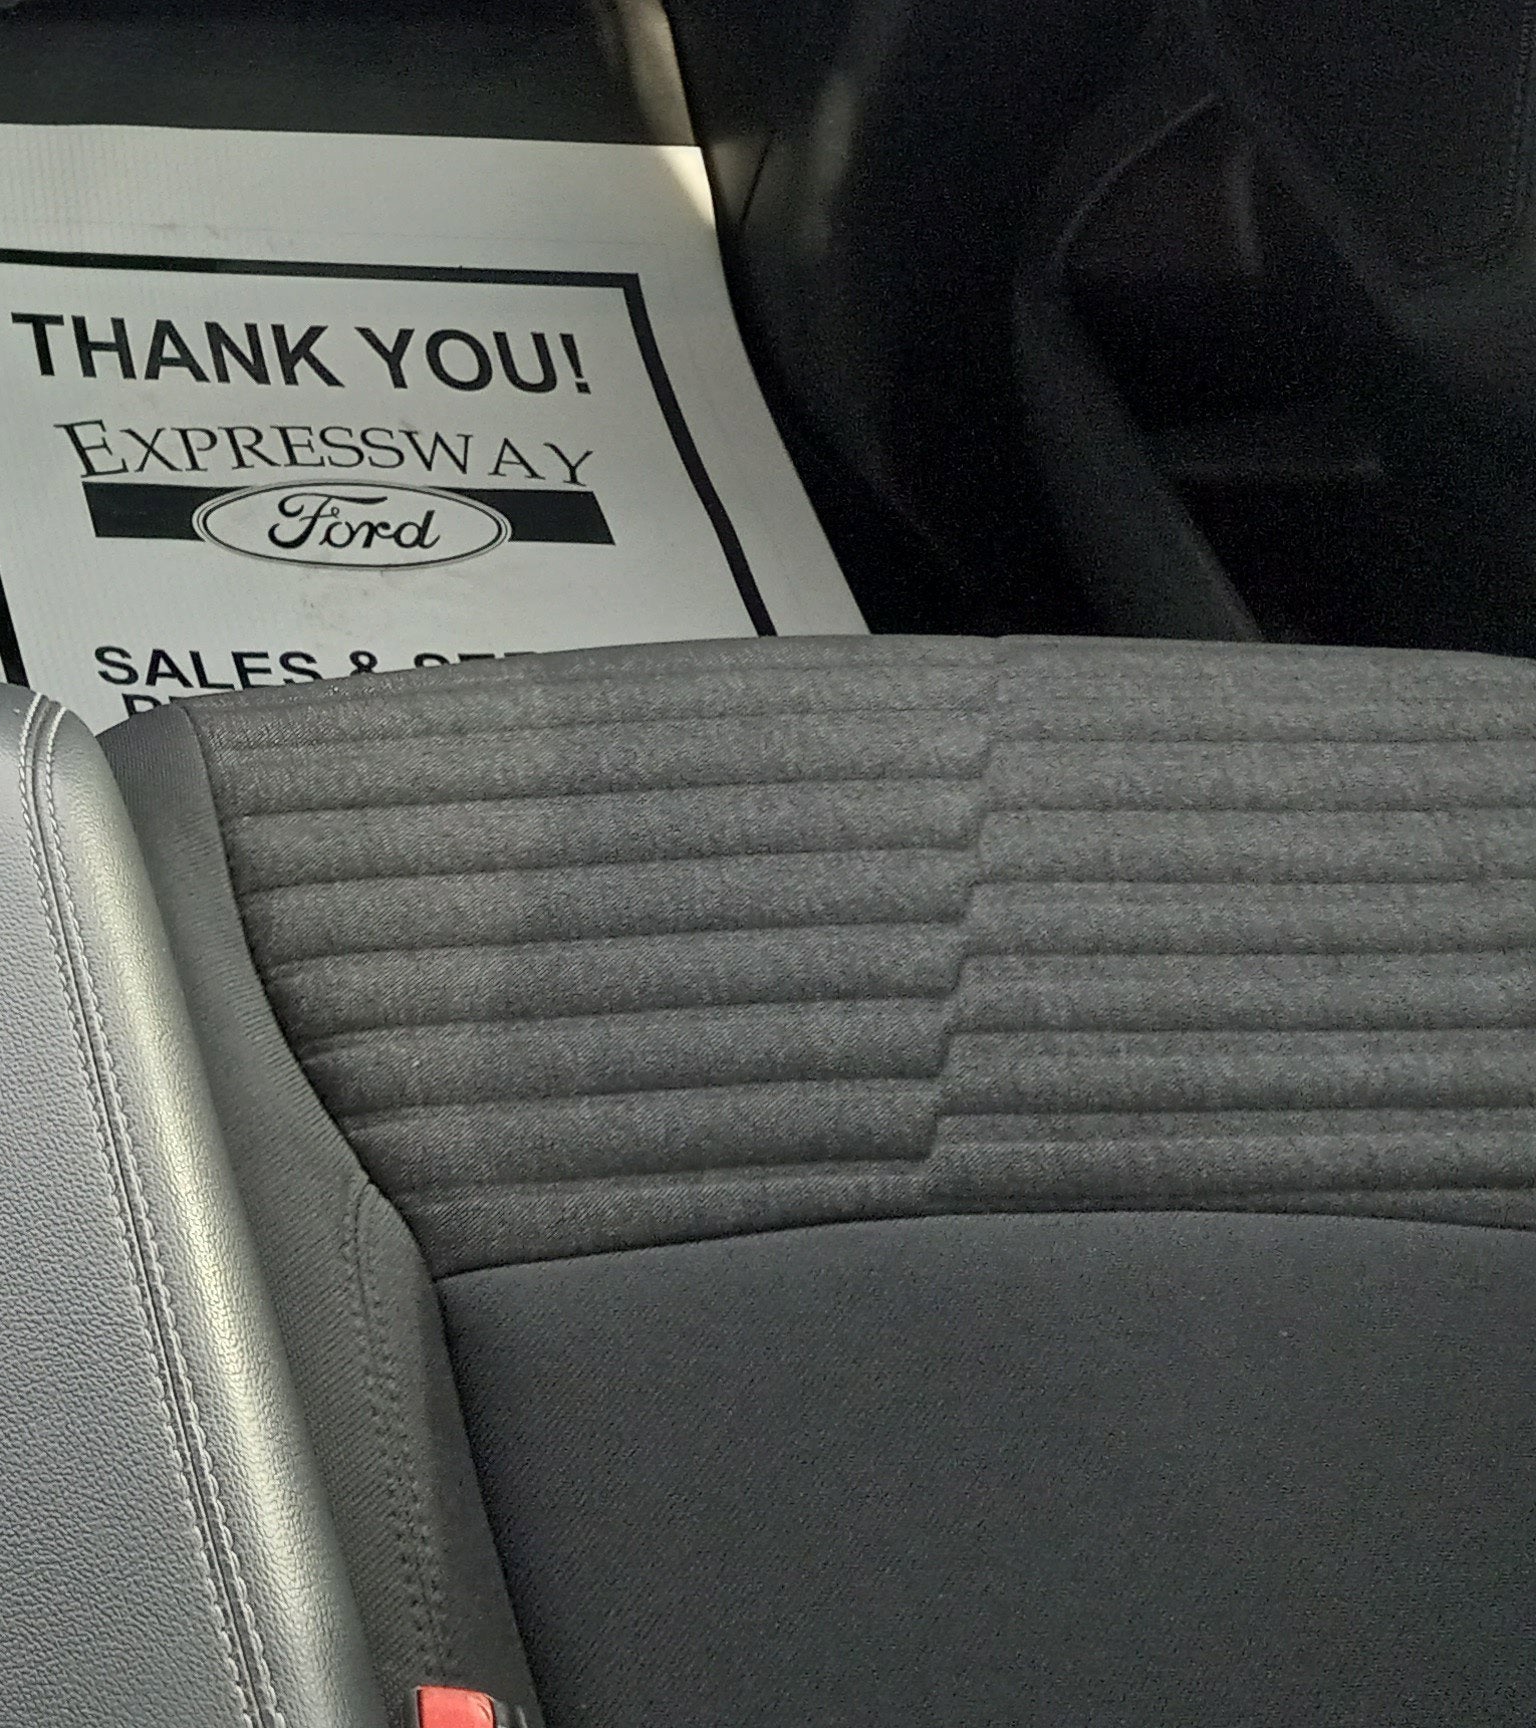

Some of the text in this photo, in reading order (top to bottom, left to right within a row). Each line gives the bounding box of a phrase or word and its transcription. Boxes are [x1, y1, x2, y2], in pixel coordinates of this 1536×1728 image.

[10, 310, 592, 394] THANK YOU!
[53, 418, 595, 488] EXPRESSWAY
[267, 490, 442, 552] Ford
[94, 645, 323, 690] SALES
